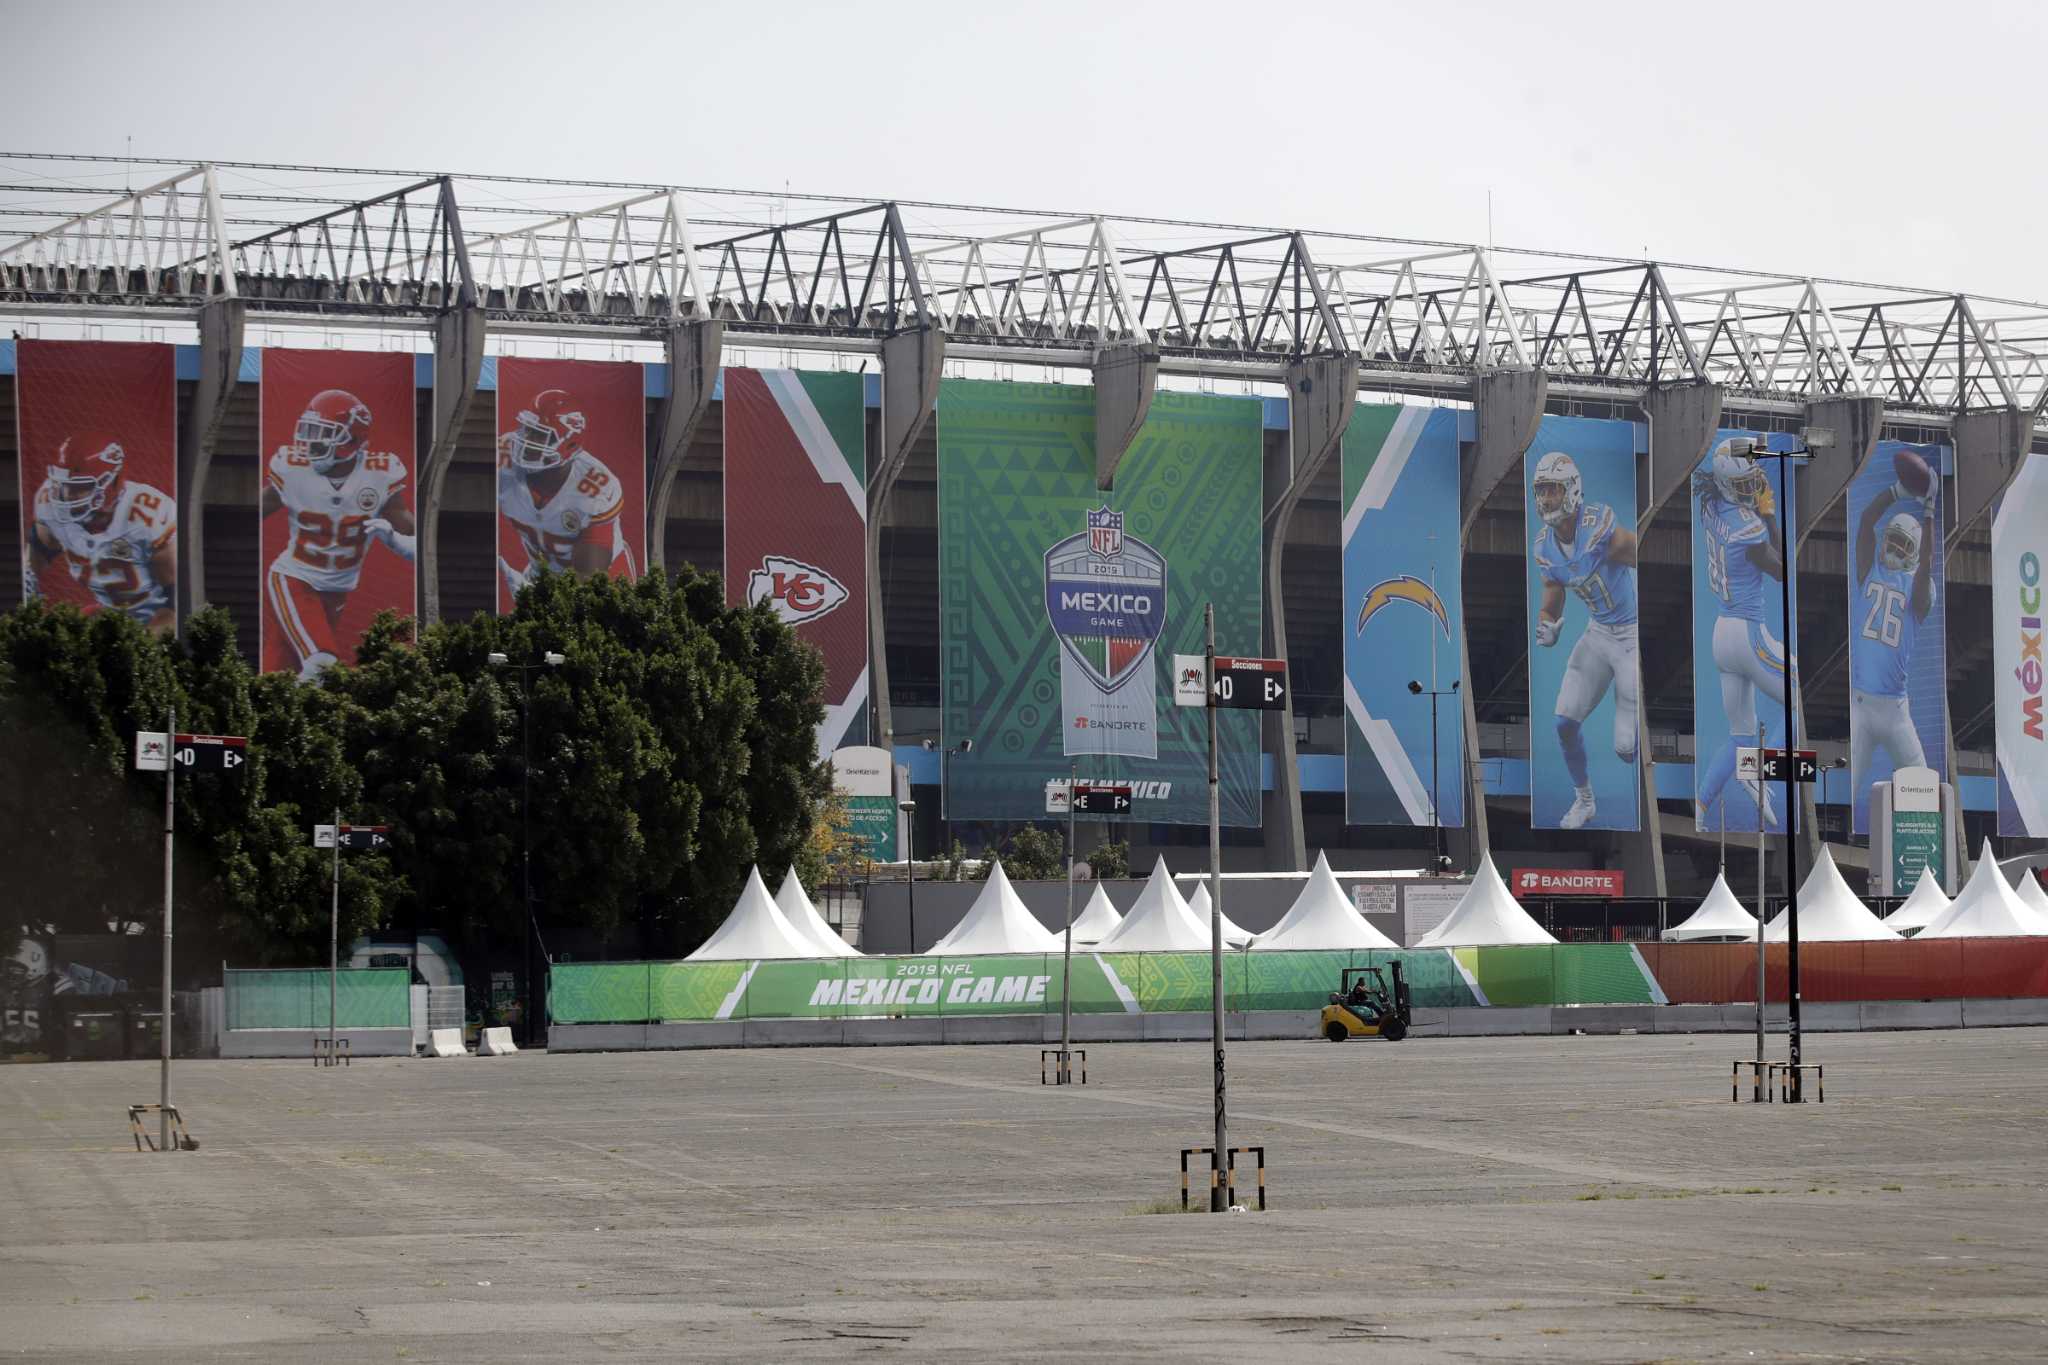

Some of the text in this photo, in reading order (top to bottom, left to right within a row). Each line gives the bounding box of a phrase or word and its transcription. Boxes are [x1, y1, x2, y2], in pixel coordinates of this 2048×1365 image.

[129, 492, 161, 527] 72
[292, 511, 372, 571] 29
[1091, 528, 1119, 554] NFL
[1094, 564, 1118, 575] 2019
[772, 572, 825, 612] KC
[1061, 591, 1152, 615] MEXICO
[1090, 617, 1124, 627] GAME
[1862, 581, 1905, 648] 26
[1231, 659, 1263, 670] Secciones
[1221, 676, 1274, 701] D E
[1090, 720, 1146, 731] BANORTE
[183, 748, 233, 768] D E
[1769, 761, 1808, 777] E F
[1080, 796, 1122, 809] E F
[344, 834, 379, 846] E F
[1541, 876, 1613, 888] BANORTE
[897, 964, 974, 976] 2019 NFL
[808, 976, 1052, 1006] MEXICO GAME
